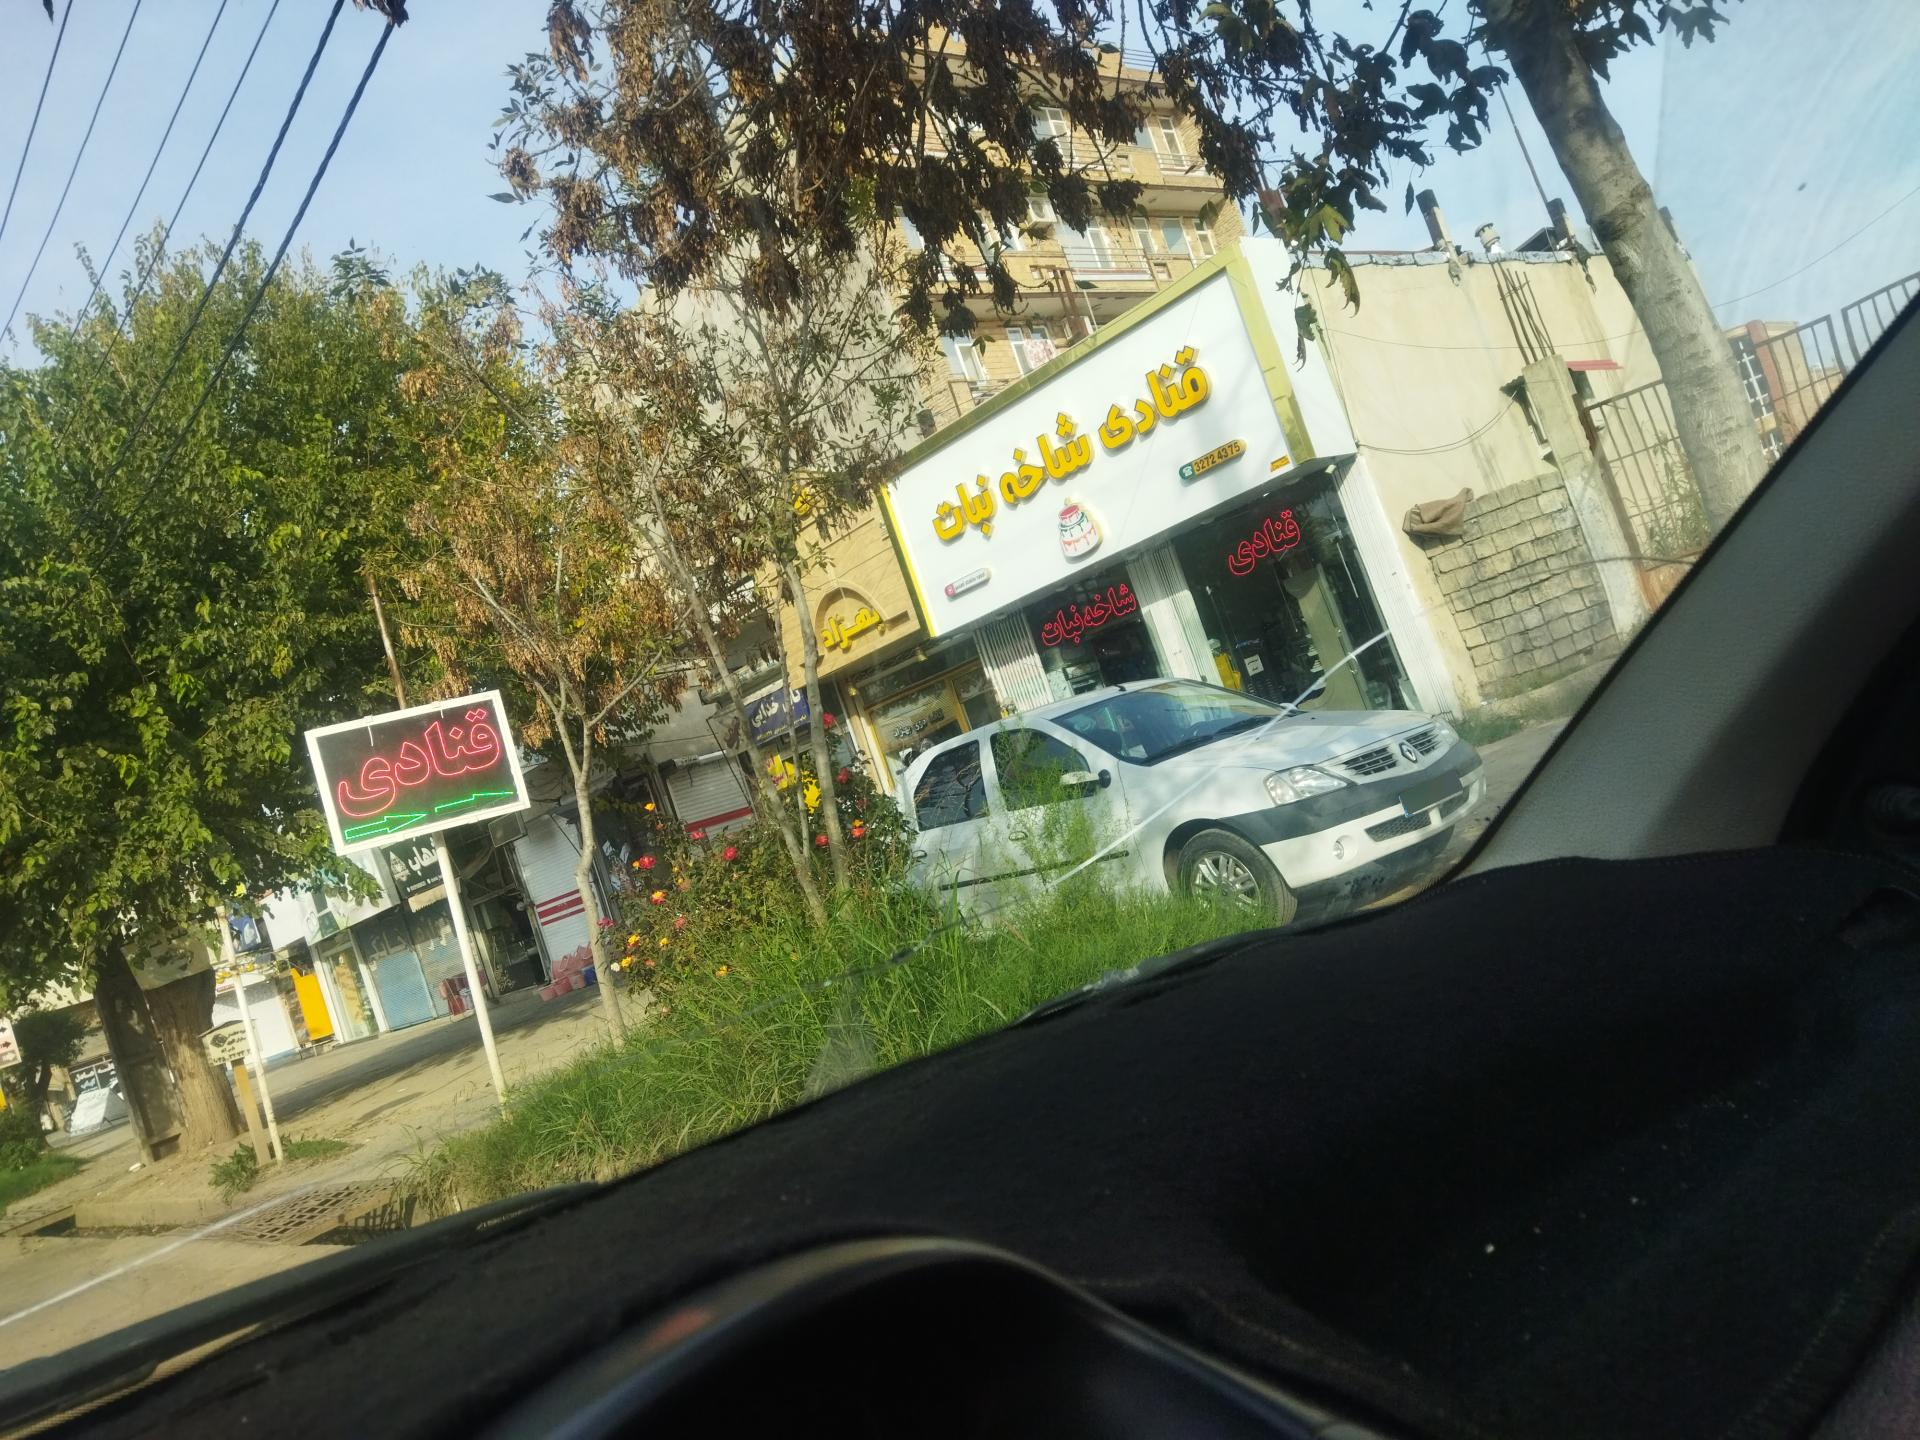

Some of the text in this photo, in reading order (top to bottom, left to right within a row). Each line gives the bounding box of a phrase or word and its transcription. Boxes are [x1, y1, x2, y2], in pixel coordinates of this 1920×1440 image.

[932, 345, 1212, 541] قنادی شاخه نبات
[1228, 509, 1301, 576] قنادی
[821, 606, 881, 649] بهزاد
[1041, 583, 1137, 647] شاخه نبات
[336, 708, 501, 817] قنادی
